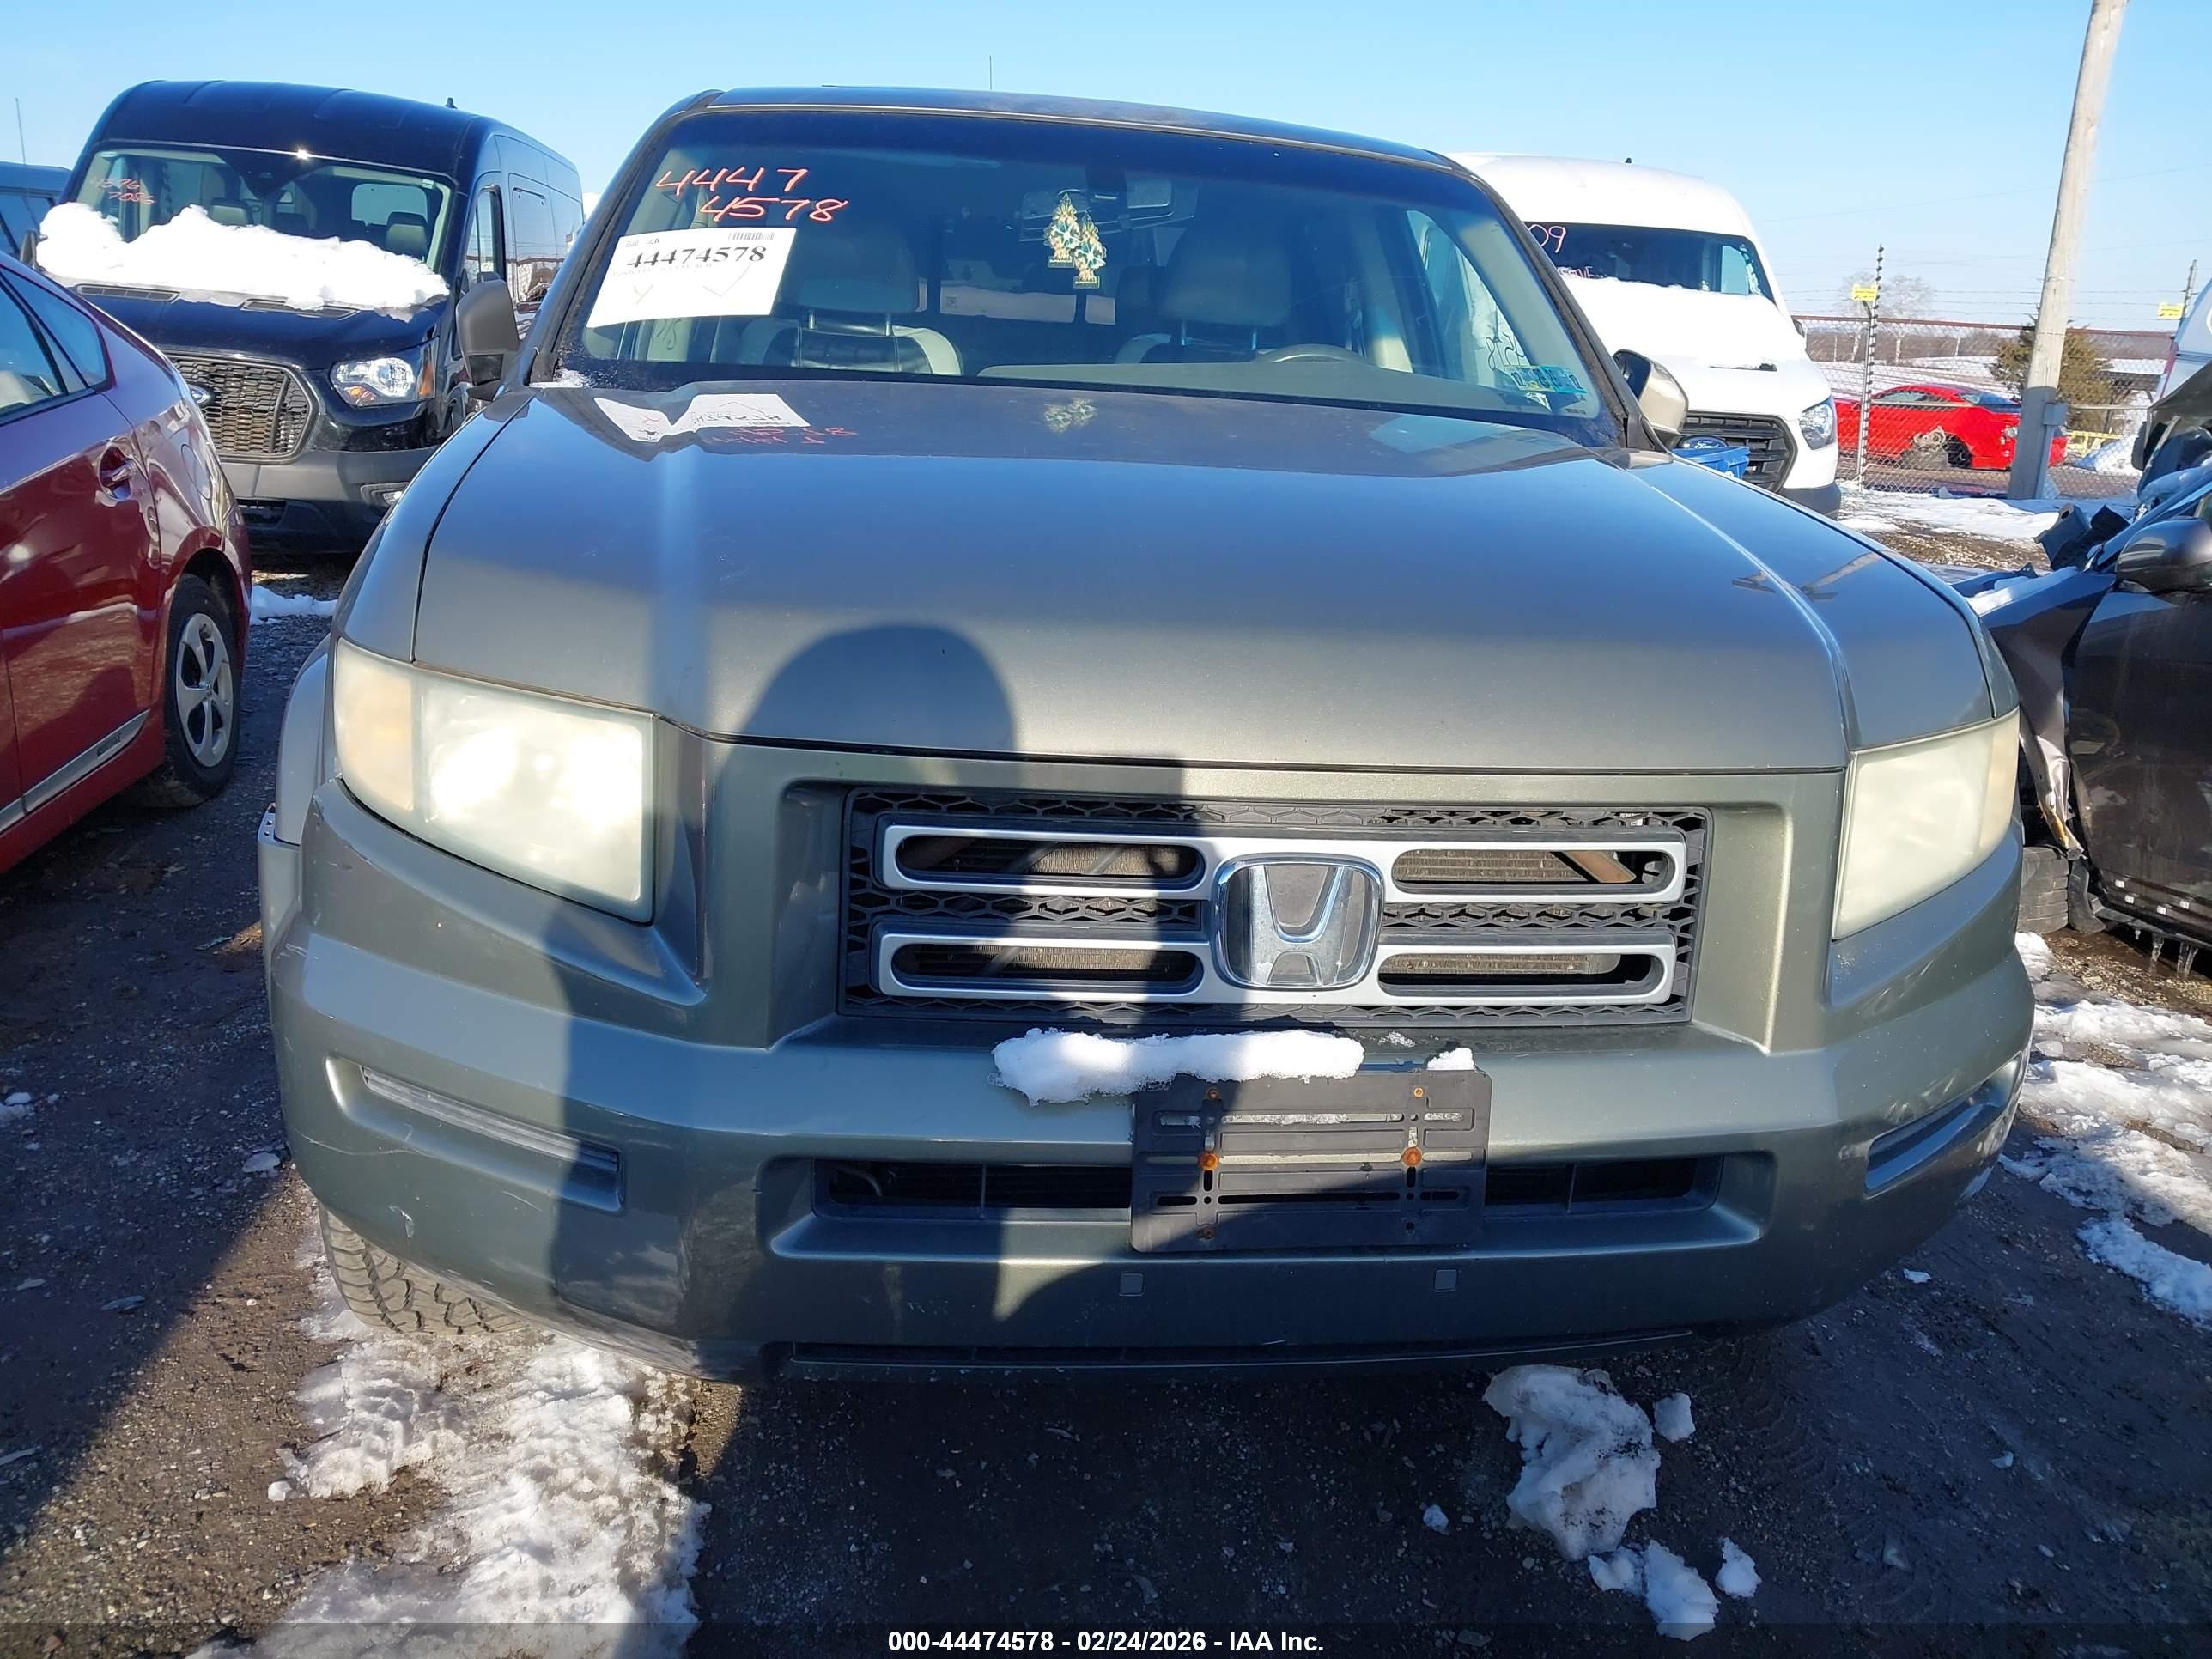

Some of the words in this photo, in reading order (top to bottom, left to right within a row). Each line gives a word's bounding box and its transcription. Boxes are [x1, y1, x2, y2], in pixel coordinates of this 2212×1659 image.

[655, 166, 810, 197] 4447
[700, 195, 848, 222] 4578
[626, 246, 767, 270] 44474578
